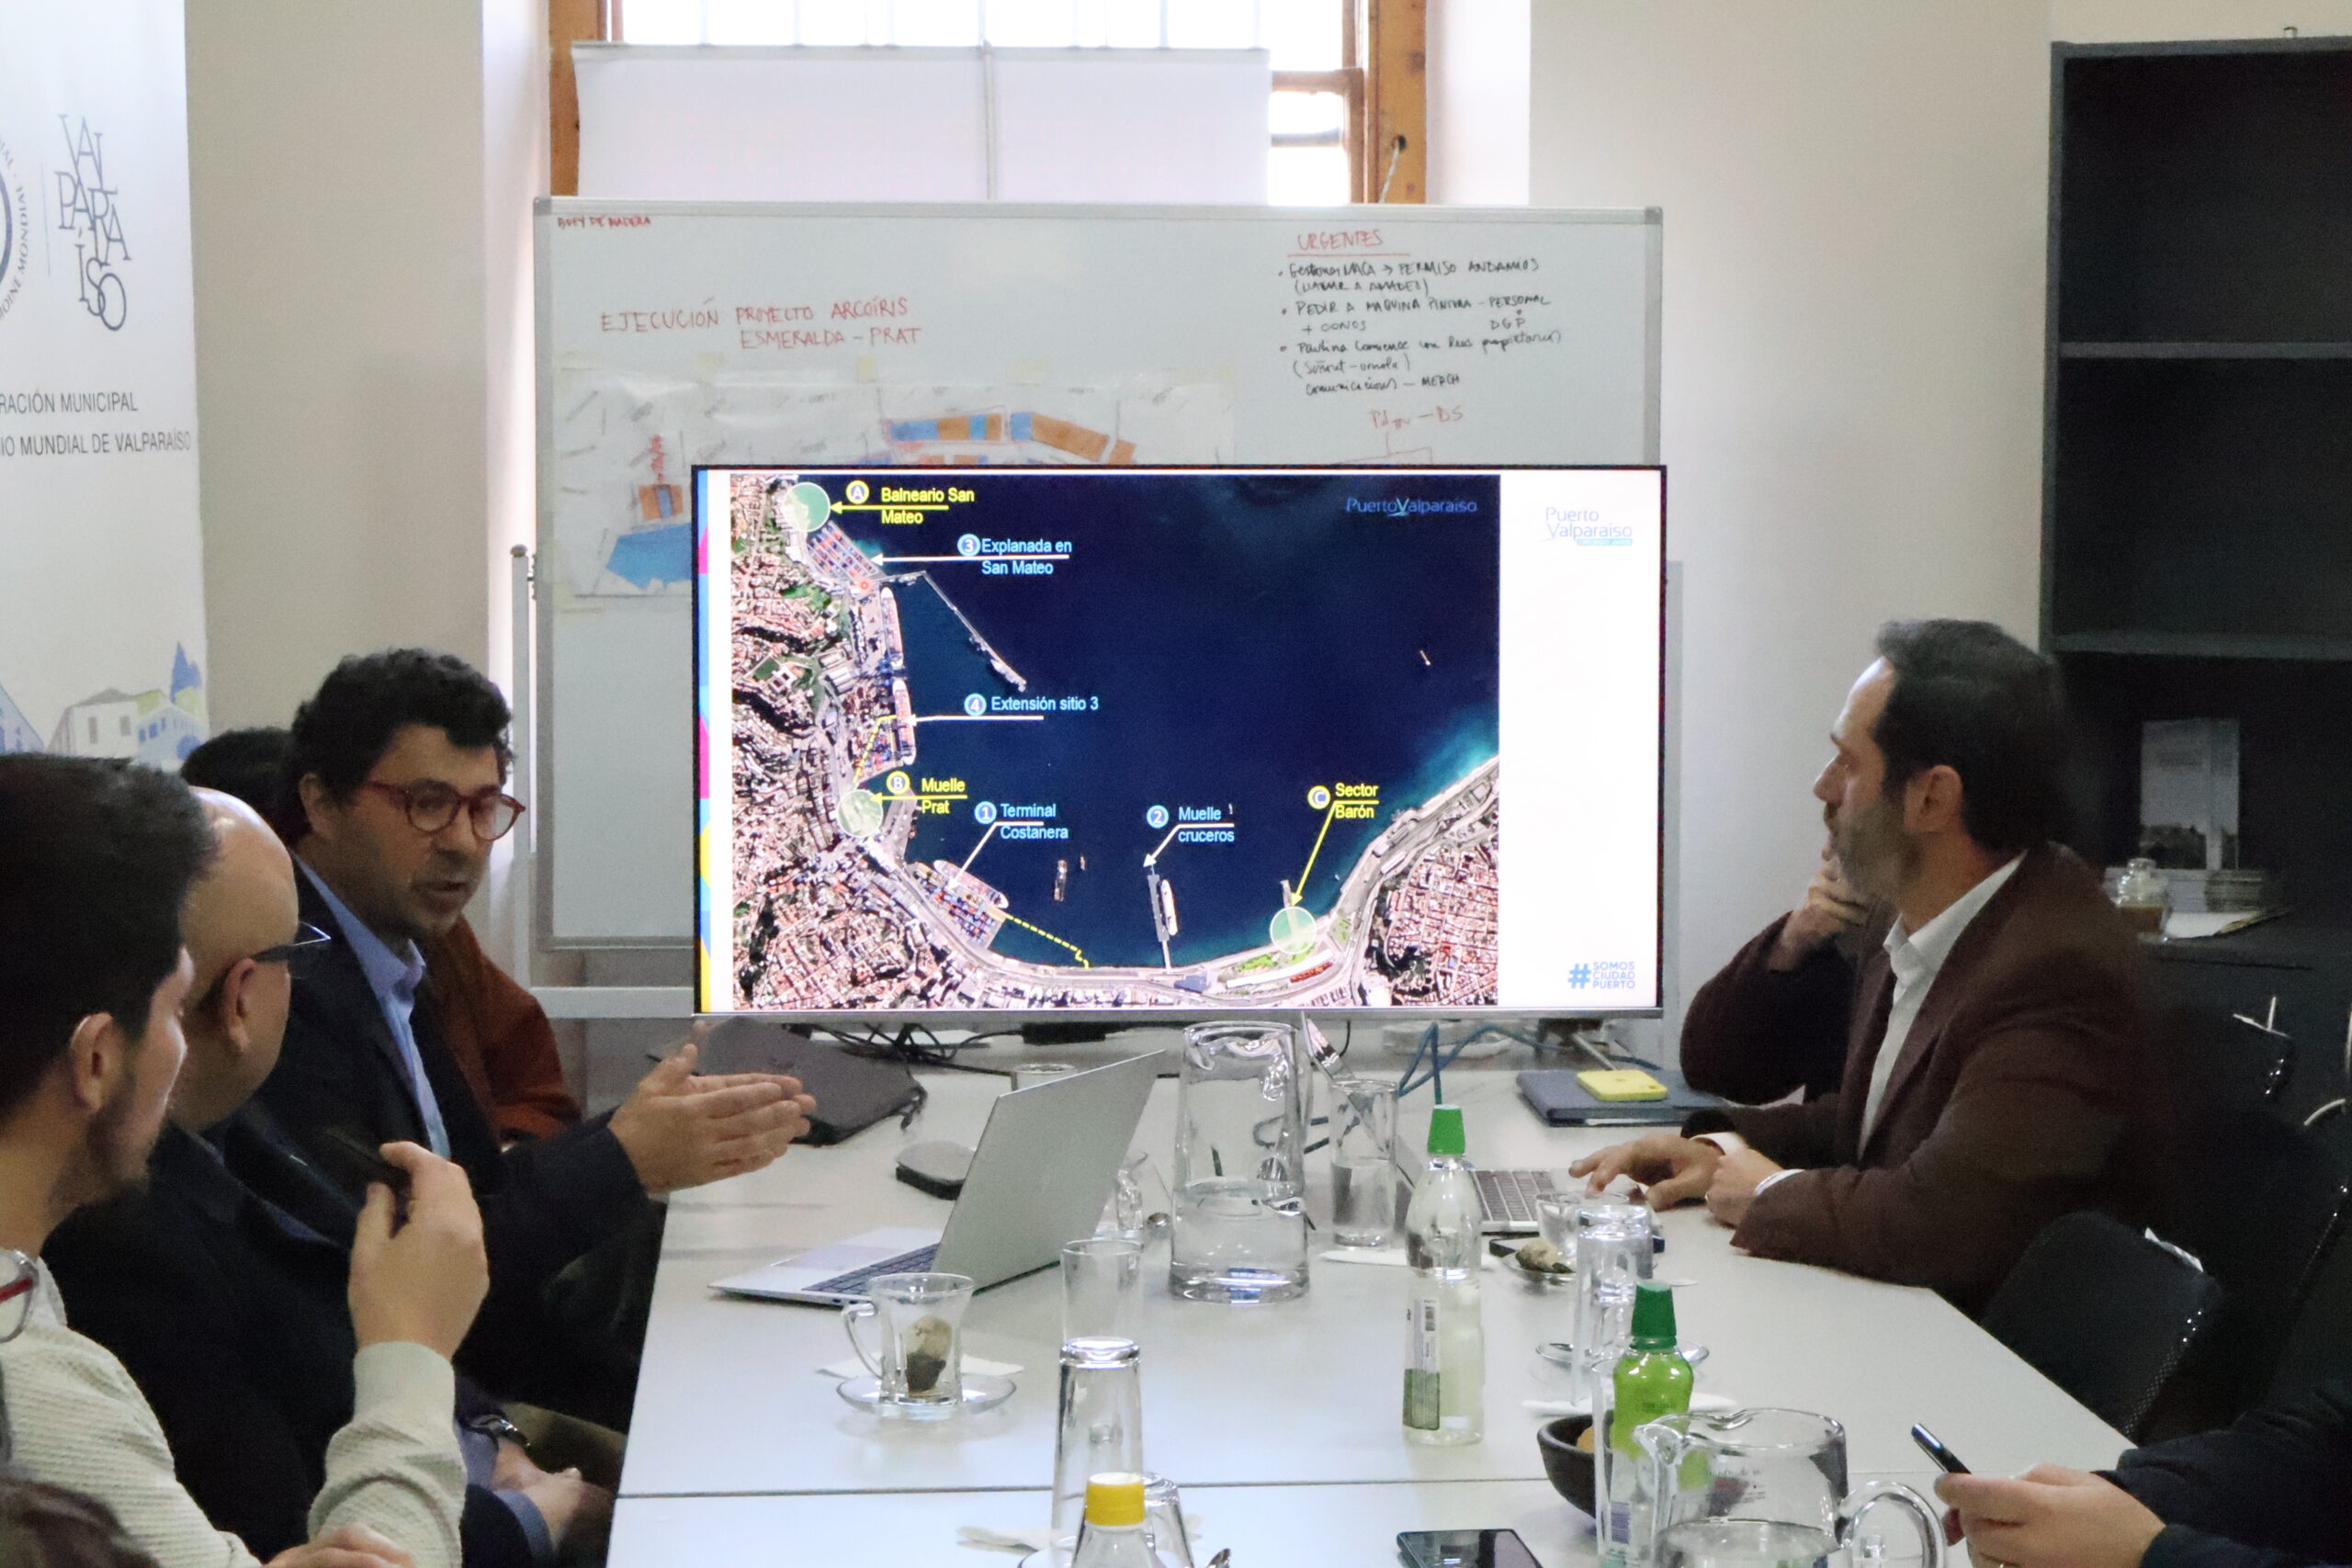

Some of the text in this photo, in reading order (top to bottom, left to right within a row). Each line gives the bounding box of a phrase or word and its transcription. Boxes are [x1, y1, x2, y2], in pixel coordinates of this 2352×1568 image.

[1297, 229, 1384, 251] URGENTES
[1398, 261, 1457, 276] PERMISO
[1295, 300, 1339, 315] PEDIR
[1488, 295, 1552, 309] PERSONAL
[735, 305, 814, 326] PROYECTO
[741, 328, 846, 349] ESMERALDA
[870, 326, 922, 347] PRAT
[61, 391, 139, 412] MUNICIPAL
[20, 434, 88, 456] MUNDIAL
[92, 434, 109, 454] DE
[115, 427, 192, 453] VALPARAÍSO
[880, 488, 975, 503] Balneario San
[880, 510, 924, 525] Mateo
[1545, 506, 1600, 522] Puerto
[981, 538, 1073, 555] Explanada en
[981, 560, 1054, 575] San Mateo
[991, 696, 1099, 712] Extensión sitio 3
[922, 778, 966, 793] Muelle
[1335, 783, 1379, 797] Sector
[922, 800, 950, 815] Prat
[1000, 804, 1057, 818] Terminal
[1179, 807, 1222, 821] Muelle
[1335, 804, 1374, 819] Barón
[1000, 825, 1069, 840] Costanera
[1178, 830, 1235, 843] cruceros
[1592, 961, 1635, 971] SOMOS
[1592, 971, 1635, 980] CIUDAD
[1592, 980, 1635, 989] PUERTO
